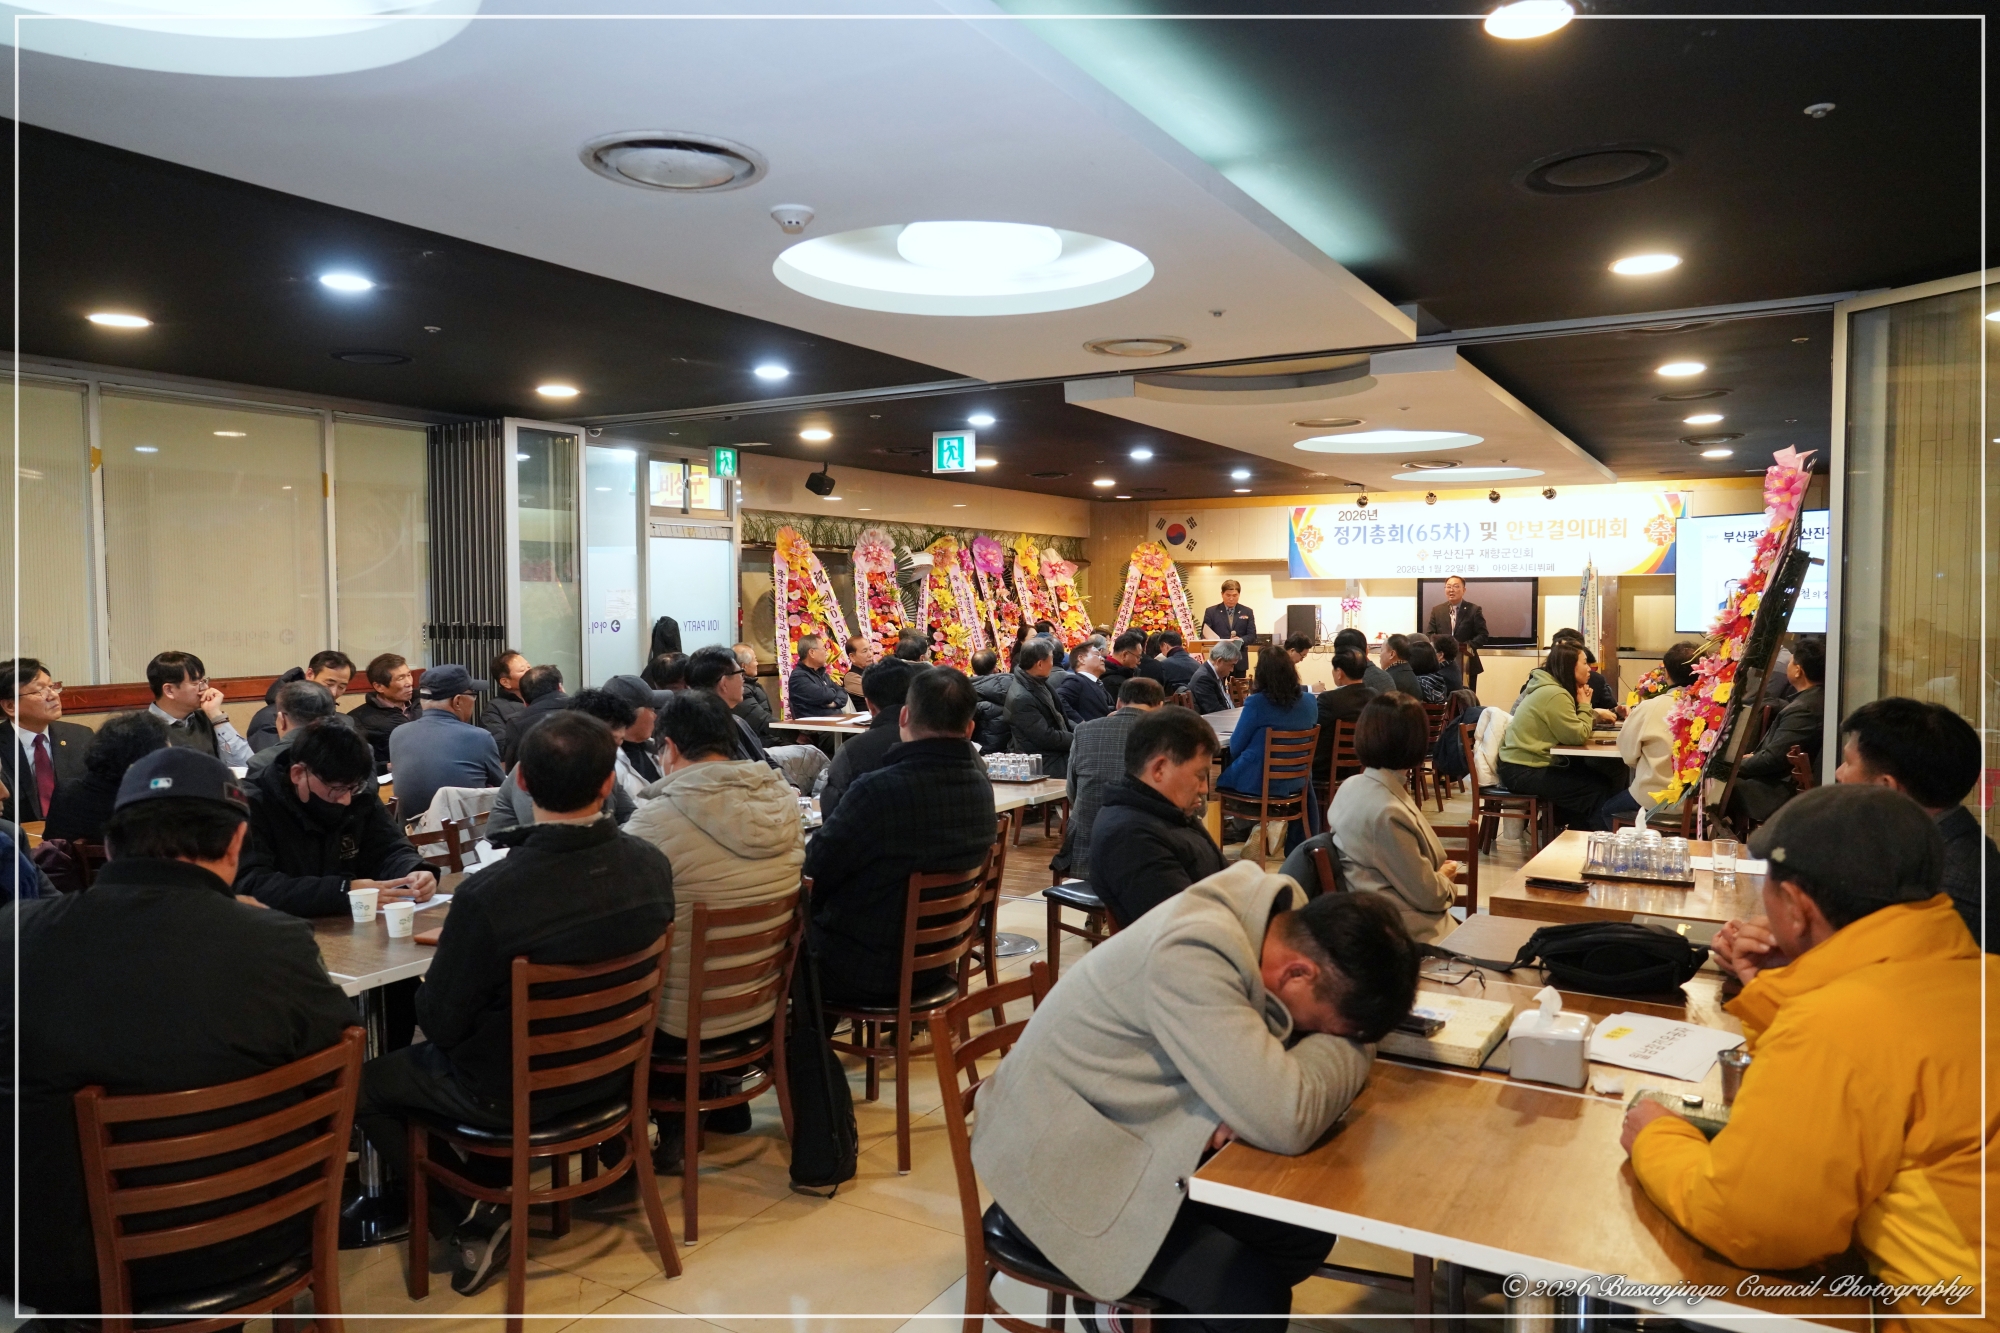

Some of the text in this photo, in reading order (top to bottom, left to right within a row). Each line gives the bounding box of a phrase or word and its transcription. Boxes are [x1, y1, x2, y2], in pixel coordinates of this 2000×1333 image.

[1338, 510, 1378, 522] 2026년
[1333, 517, 1629, 546] 정기총회(65차) 및 안보결의대회
[1650, 520, 1670, 542] 축
[1723, 530, 1765, 543] 부산광
[1303, 530, 1317, 548] 경
[1432, 547, 1534, 561] 부산진구 재향군인회
[1396, 564, 1425, 574] 2026년
[1428, 564, 1442, 574] 1월
[1445, 564, 1480, 574] 22일(목)
